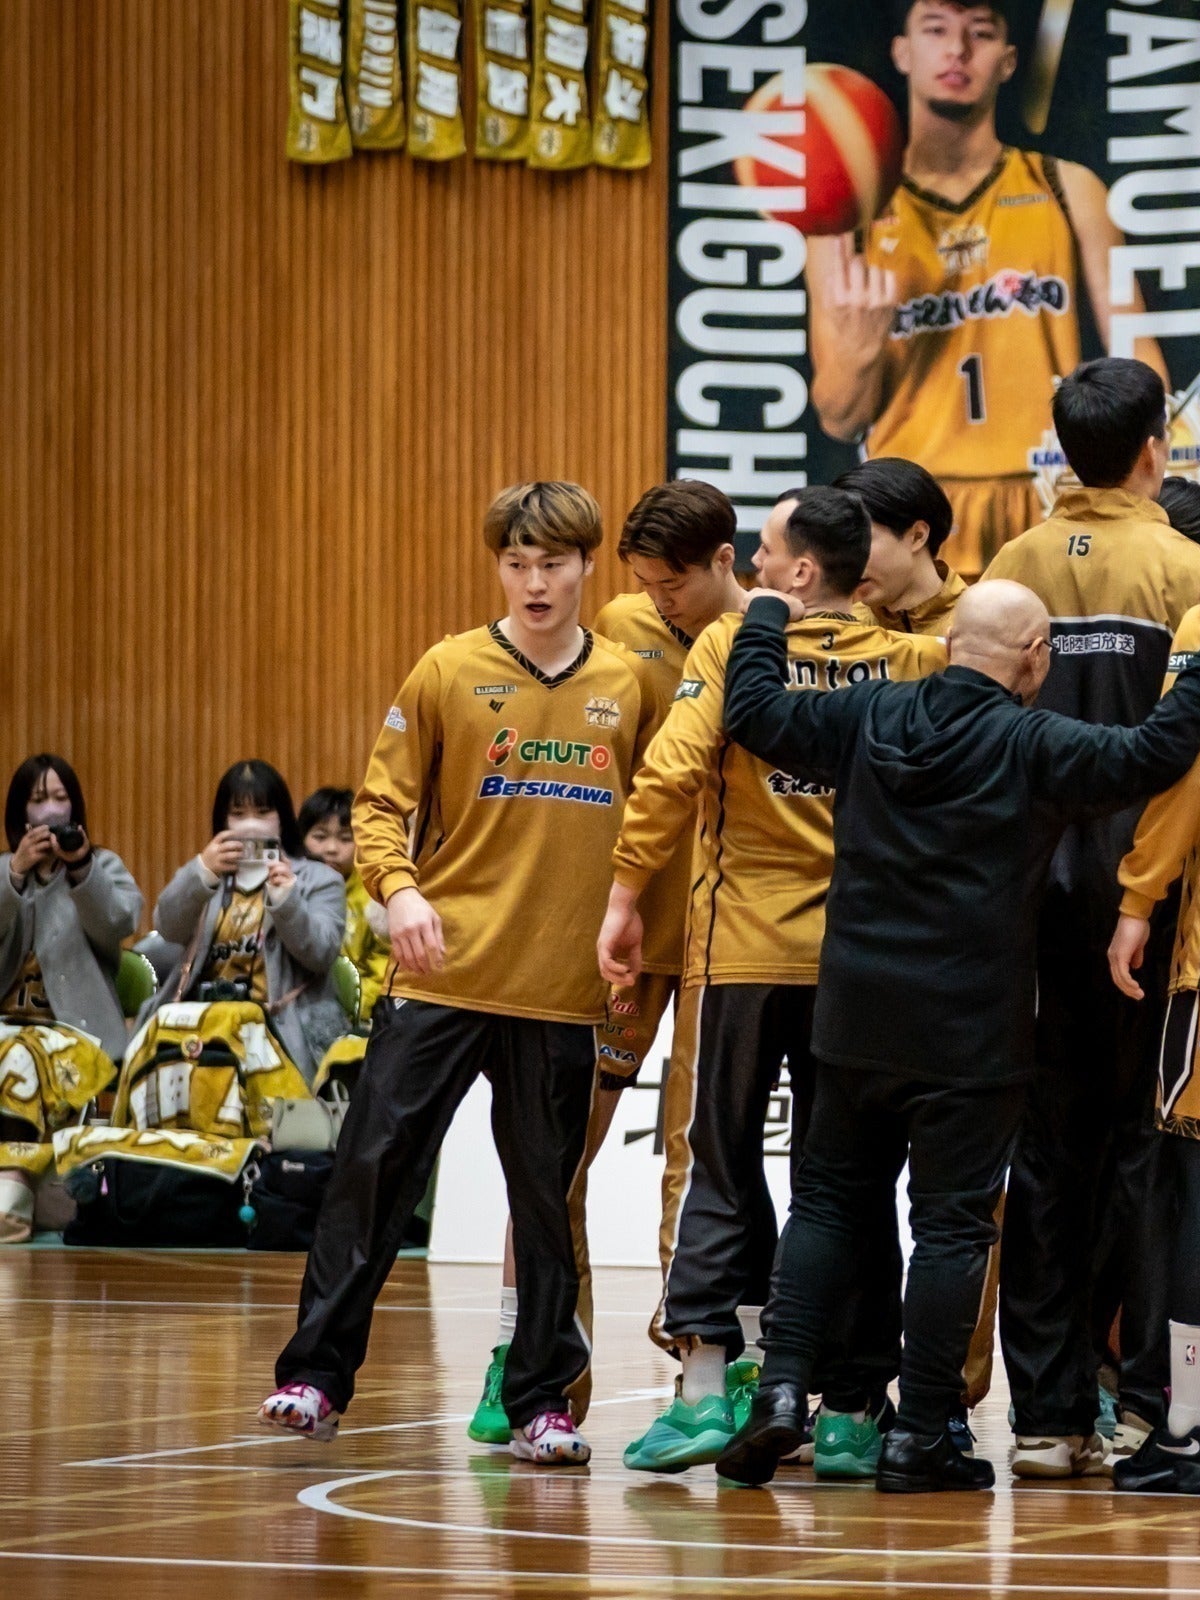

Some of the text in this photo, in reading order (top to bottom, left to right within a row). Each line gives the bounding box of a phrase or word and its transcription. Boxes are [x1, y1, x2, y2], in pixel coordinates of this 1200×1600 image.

[958, 353, 986, 423] 1
[1067, 534, 1092, 557] 15
[822, 632, 834, 650] 3
[519, 740, 610, 770] CHUTO
[478, 775, 613, 805] BETSUKAWA
